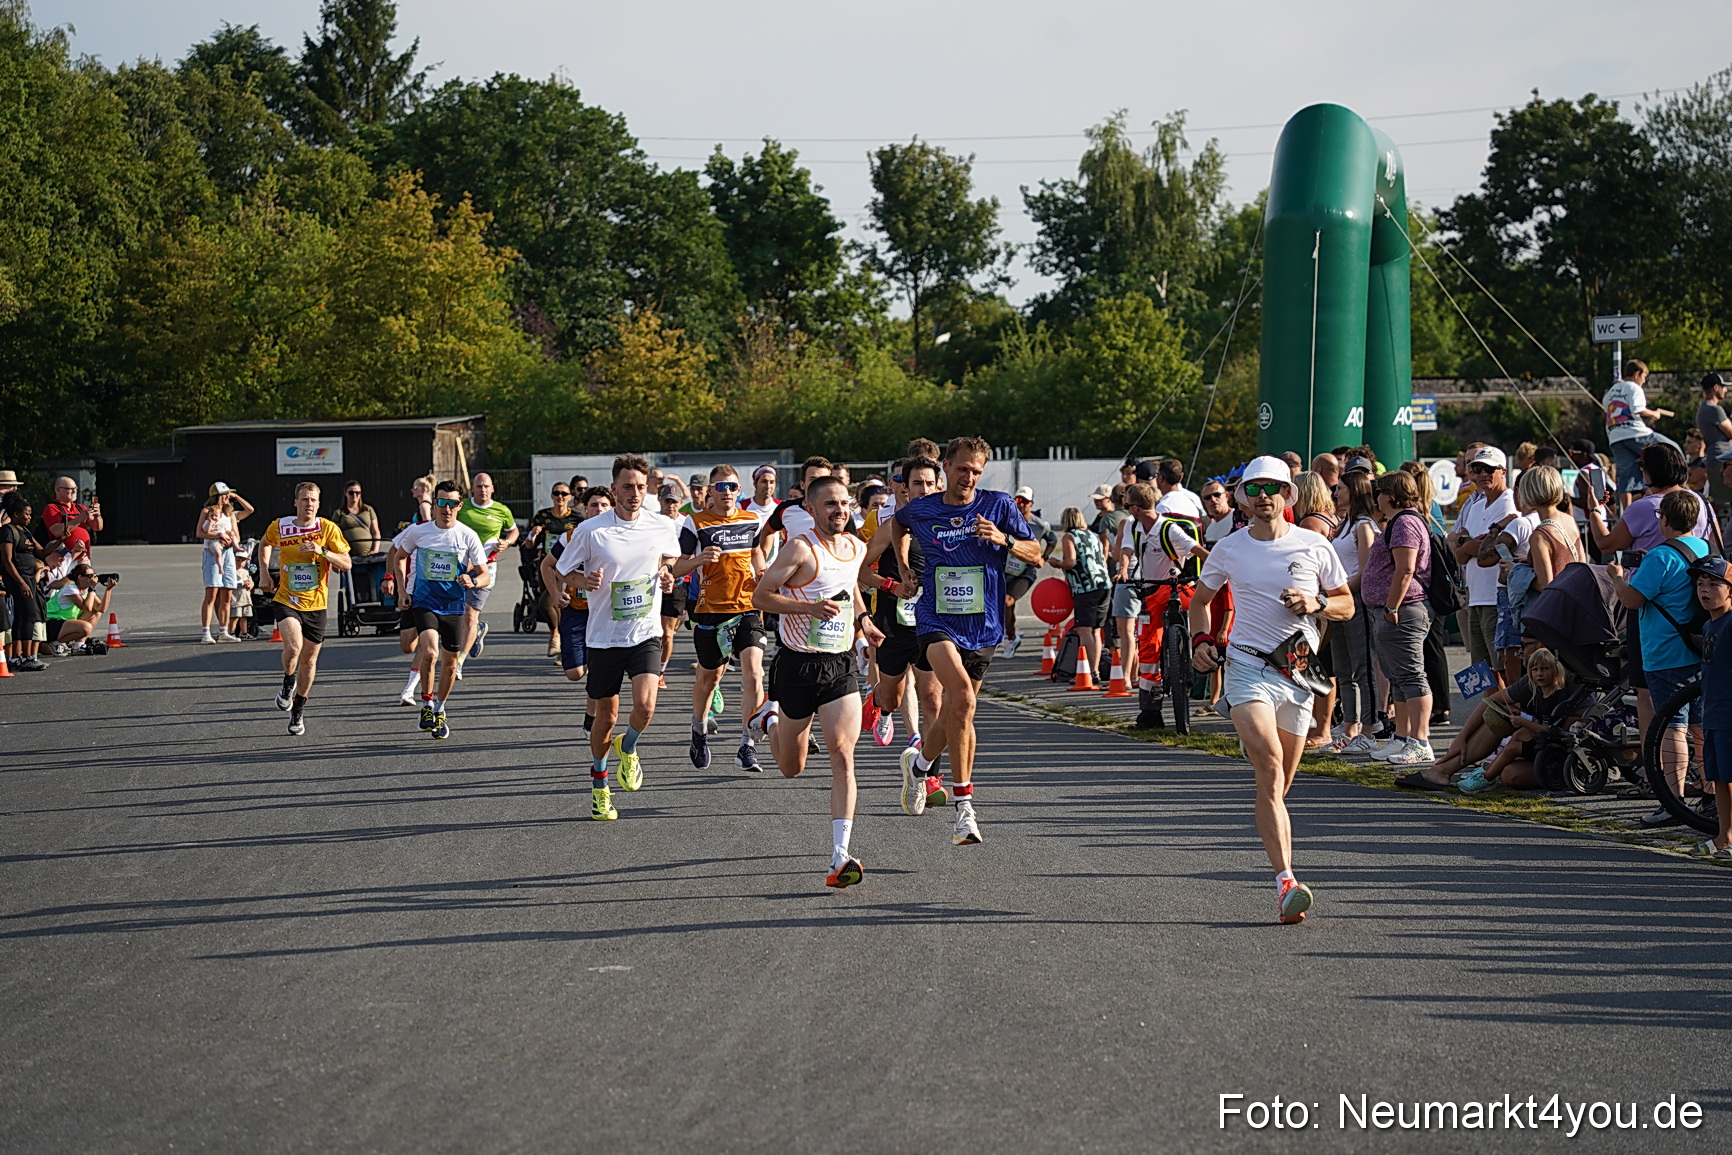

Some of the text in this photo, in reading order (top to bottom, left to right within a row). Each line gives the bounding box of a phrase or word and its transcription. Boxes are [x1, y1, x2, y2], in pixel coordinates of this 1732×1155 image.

[1597, 324, 1615, 334] WC
[719, 530, 750, 542] Fischer
[280, 538, 299, 547] MAX
[430, 563, 451, 571] 2448
[944, 586, 974, 596] 2859
[622, 595, 643, 605] 1518
[819, 620, 845, 632] 2363
